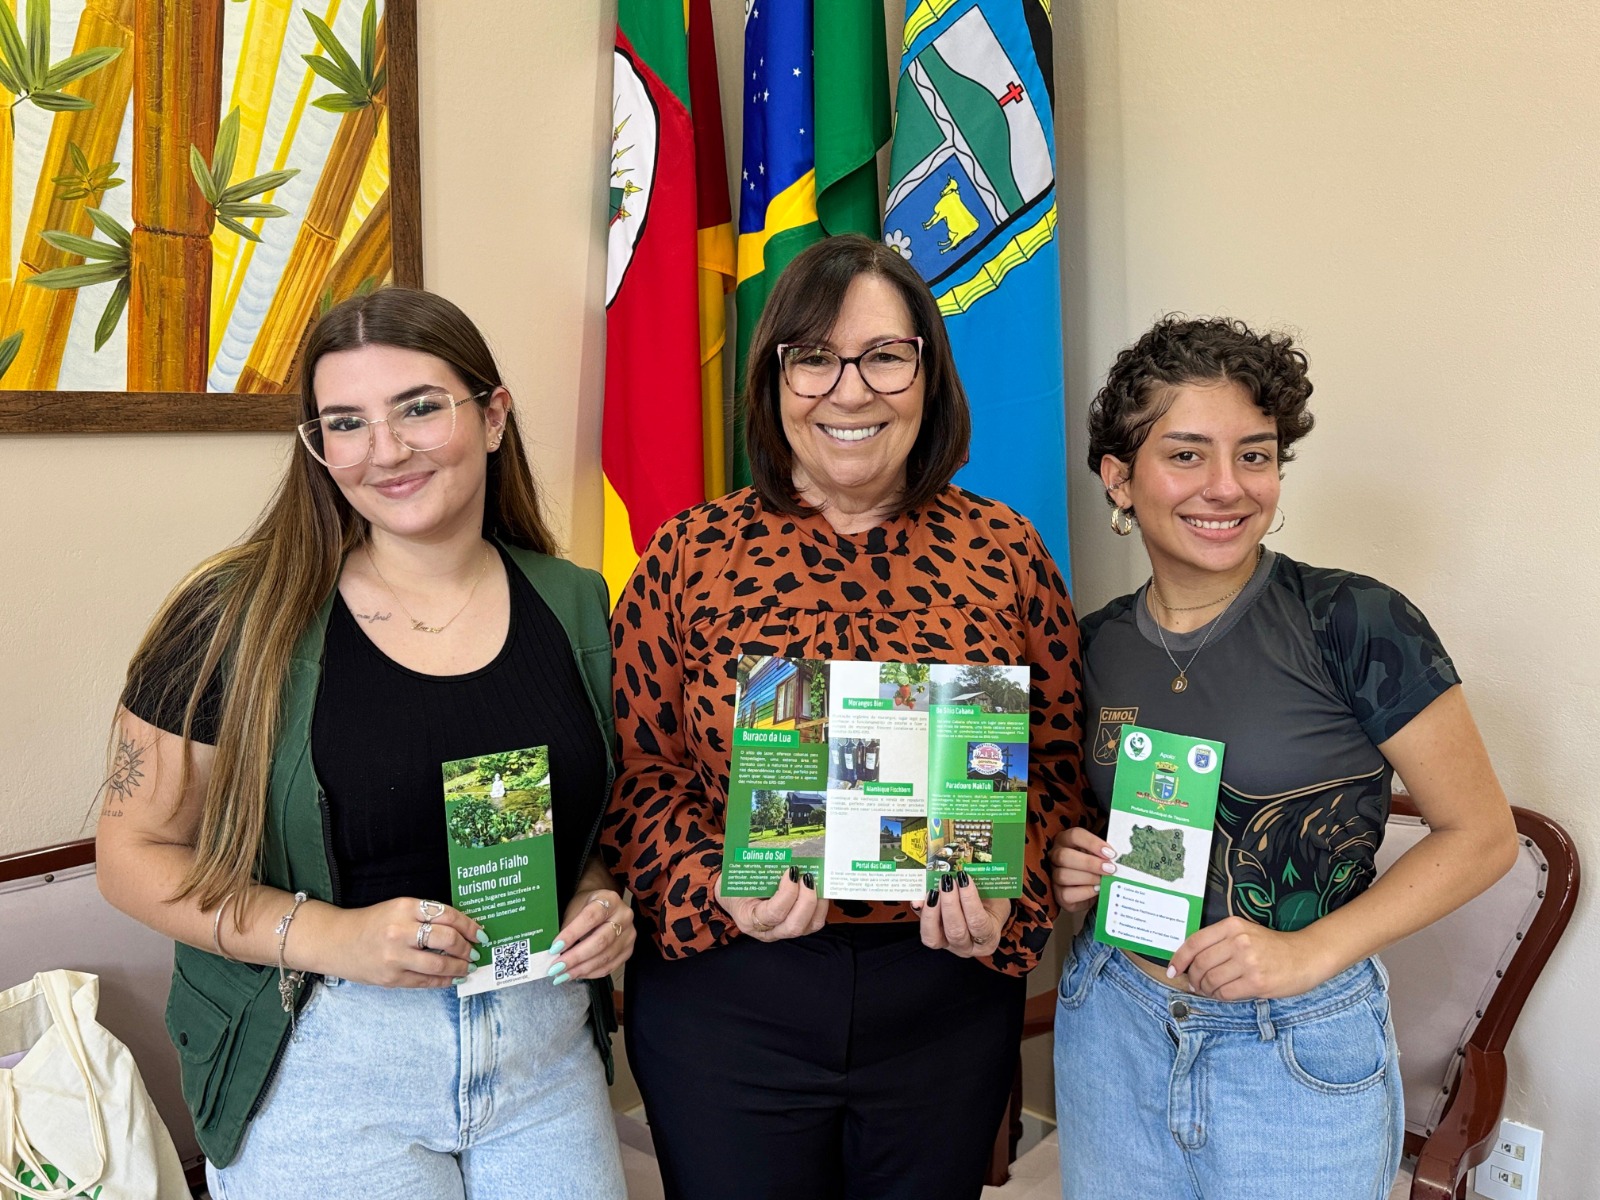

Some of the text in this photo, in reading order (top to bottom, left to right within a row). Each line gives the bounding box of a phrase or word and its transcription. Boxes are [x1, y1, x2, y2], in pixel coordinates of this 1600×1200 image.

[1174, 680, 1184, 690] D
[848, 699, 872, 708] Morangos
[1101, 710, 1134, 721] CIMOL
[742, 731, 791, 743] Buraco da Lua
[742, 850, 786, 860] Colina do Sol
[457, 854, 528, 879] Fazenda Fialho
[458, 870, 522, 896] turismo rural
[459, 897, 484, 906] Conheça
[485, 892, 506, 901] lugares
[507, 887, 531, 896] incríveis
[496, 907, 518, 917] interior
[521, 929, 544, 937] Instagram
